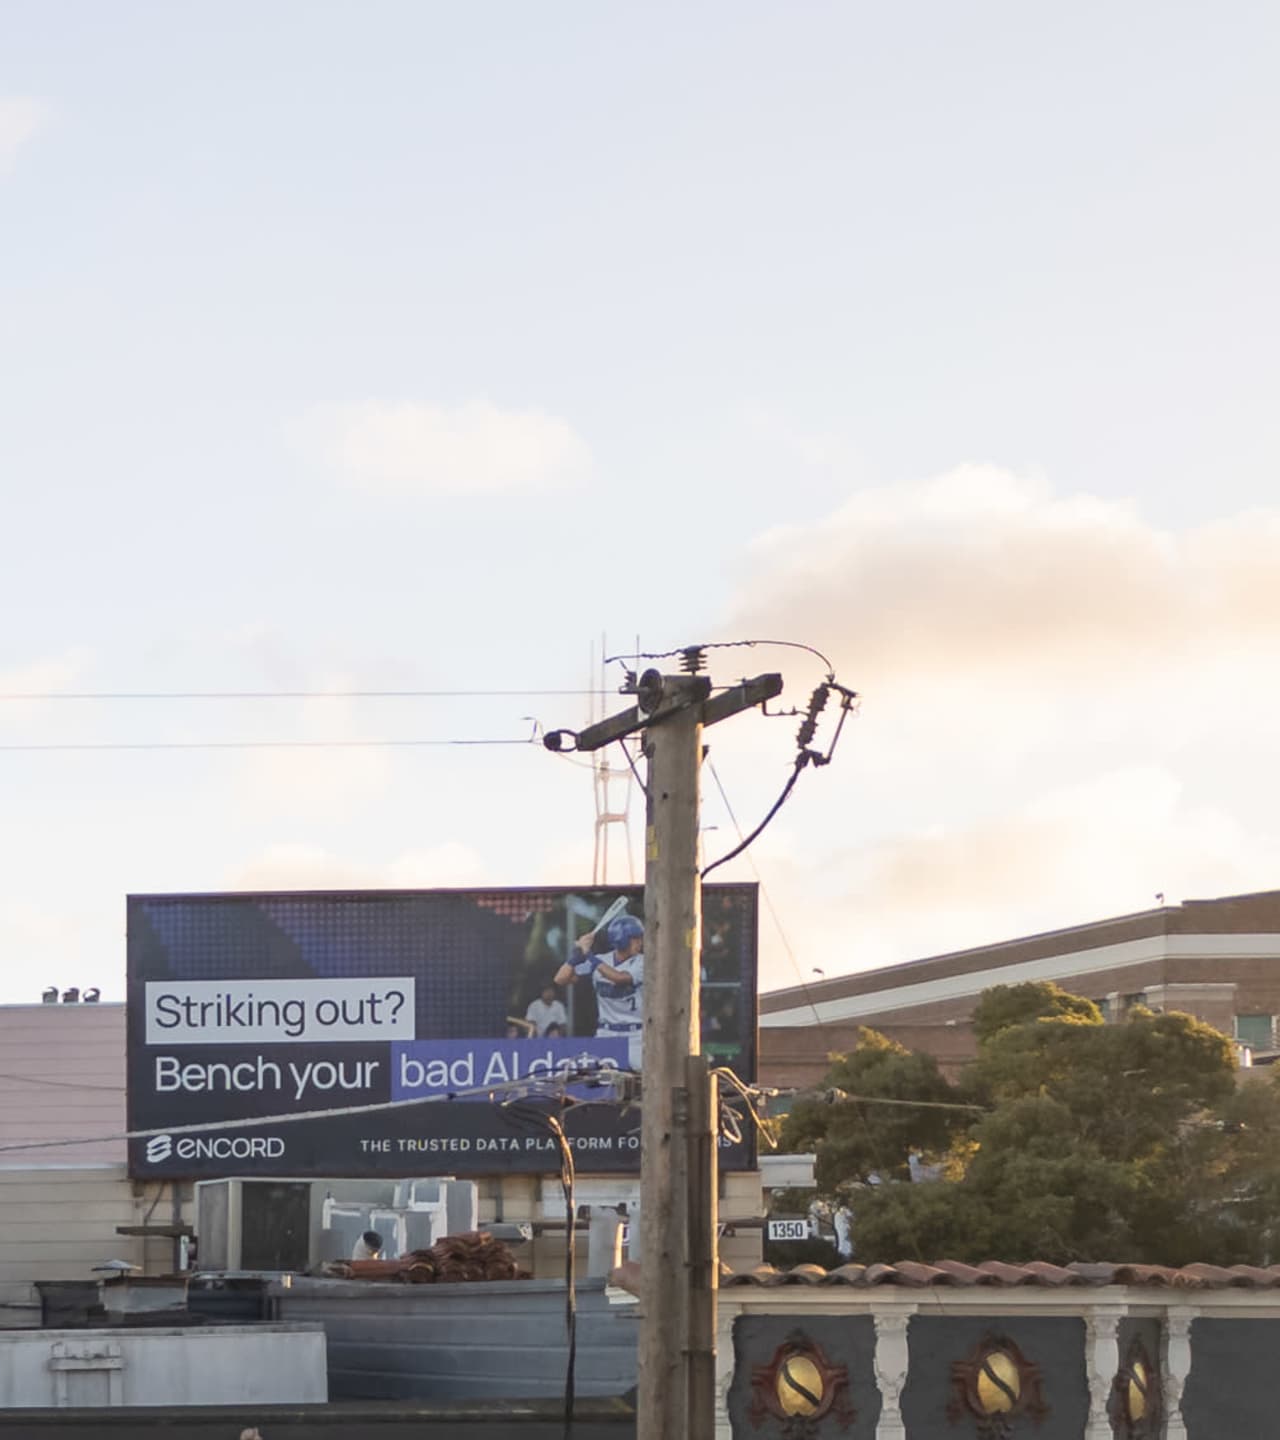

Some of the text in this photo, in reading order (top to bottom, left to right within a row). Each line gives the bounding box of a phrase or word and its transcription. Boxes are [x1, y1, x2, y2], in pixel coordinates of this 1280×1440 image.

[155, 991, 405, 1037] Striking out?
[155, 1055, 282, 1092] Bench
[289, 1061, 380, 1100] your
[400, 1052, 474, 1087] bad
[483, 1051, 519, 1086] AI
[360, 1137, 640, 1152] THE TRUSTED DATA PLAFORM FO
[772, 1222, 804, 1238] 1350
